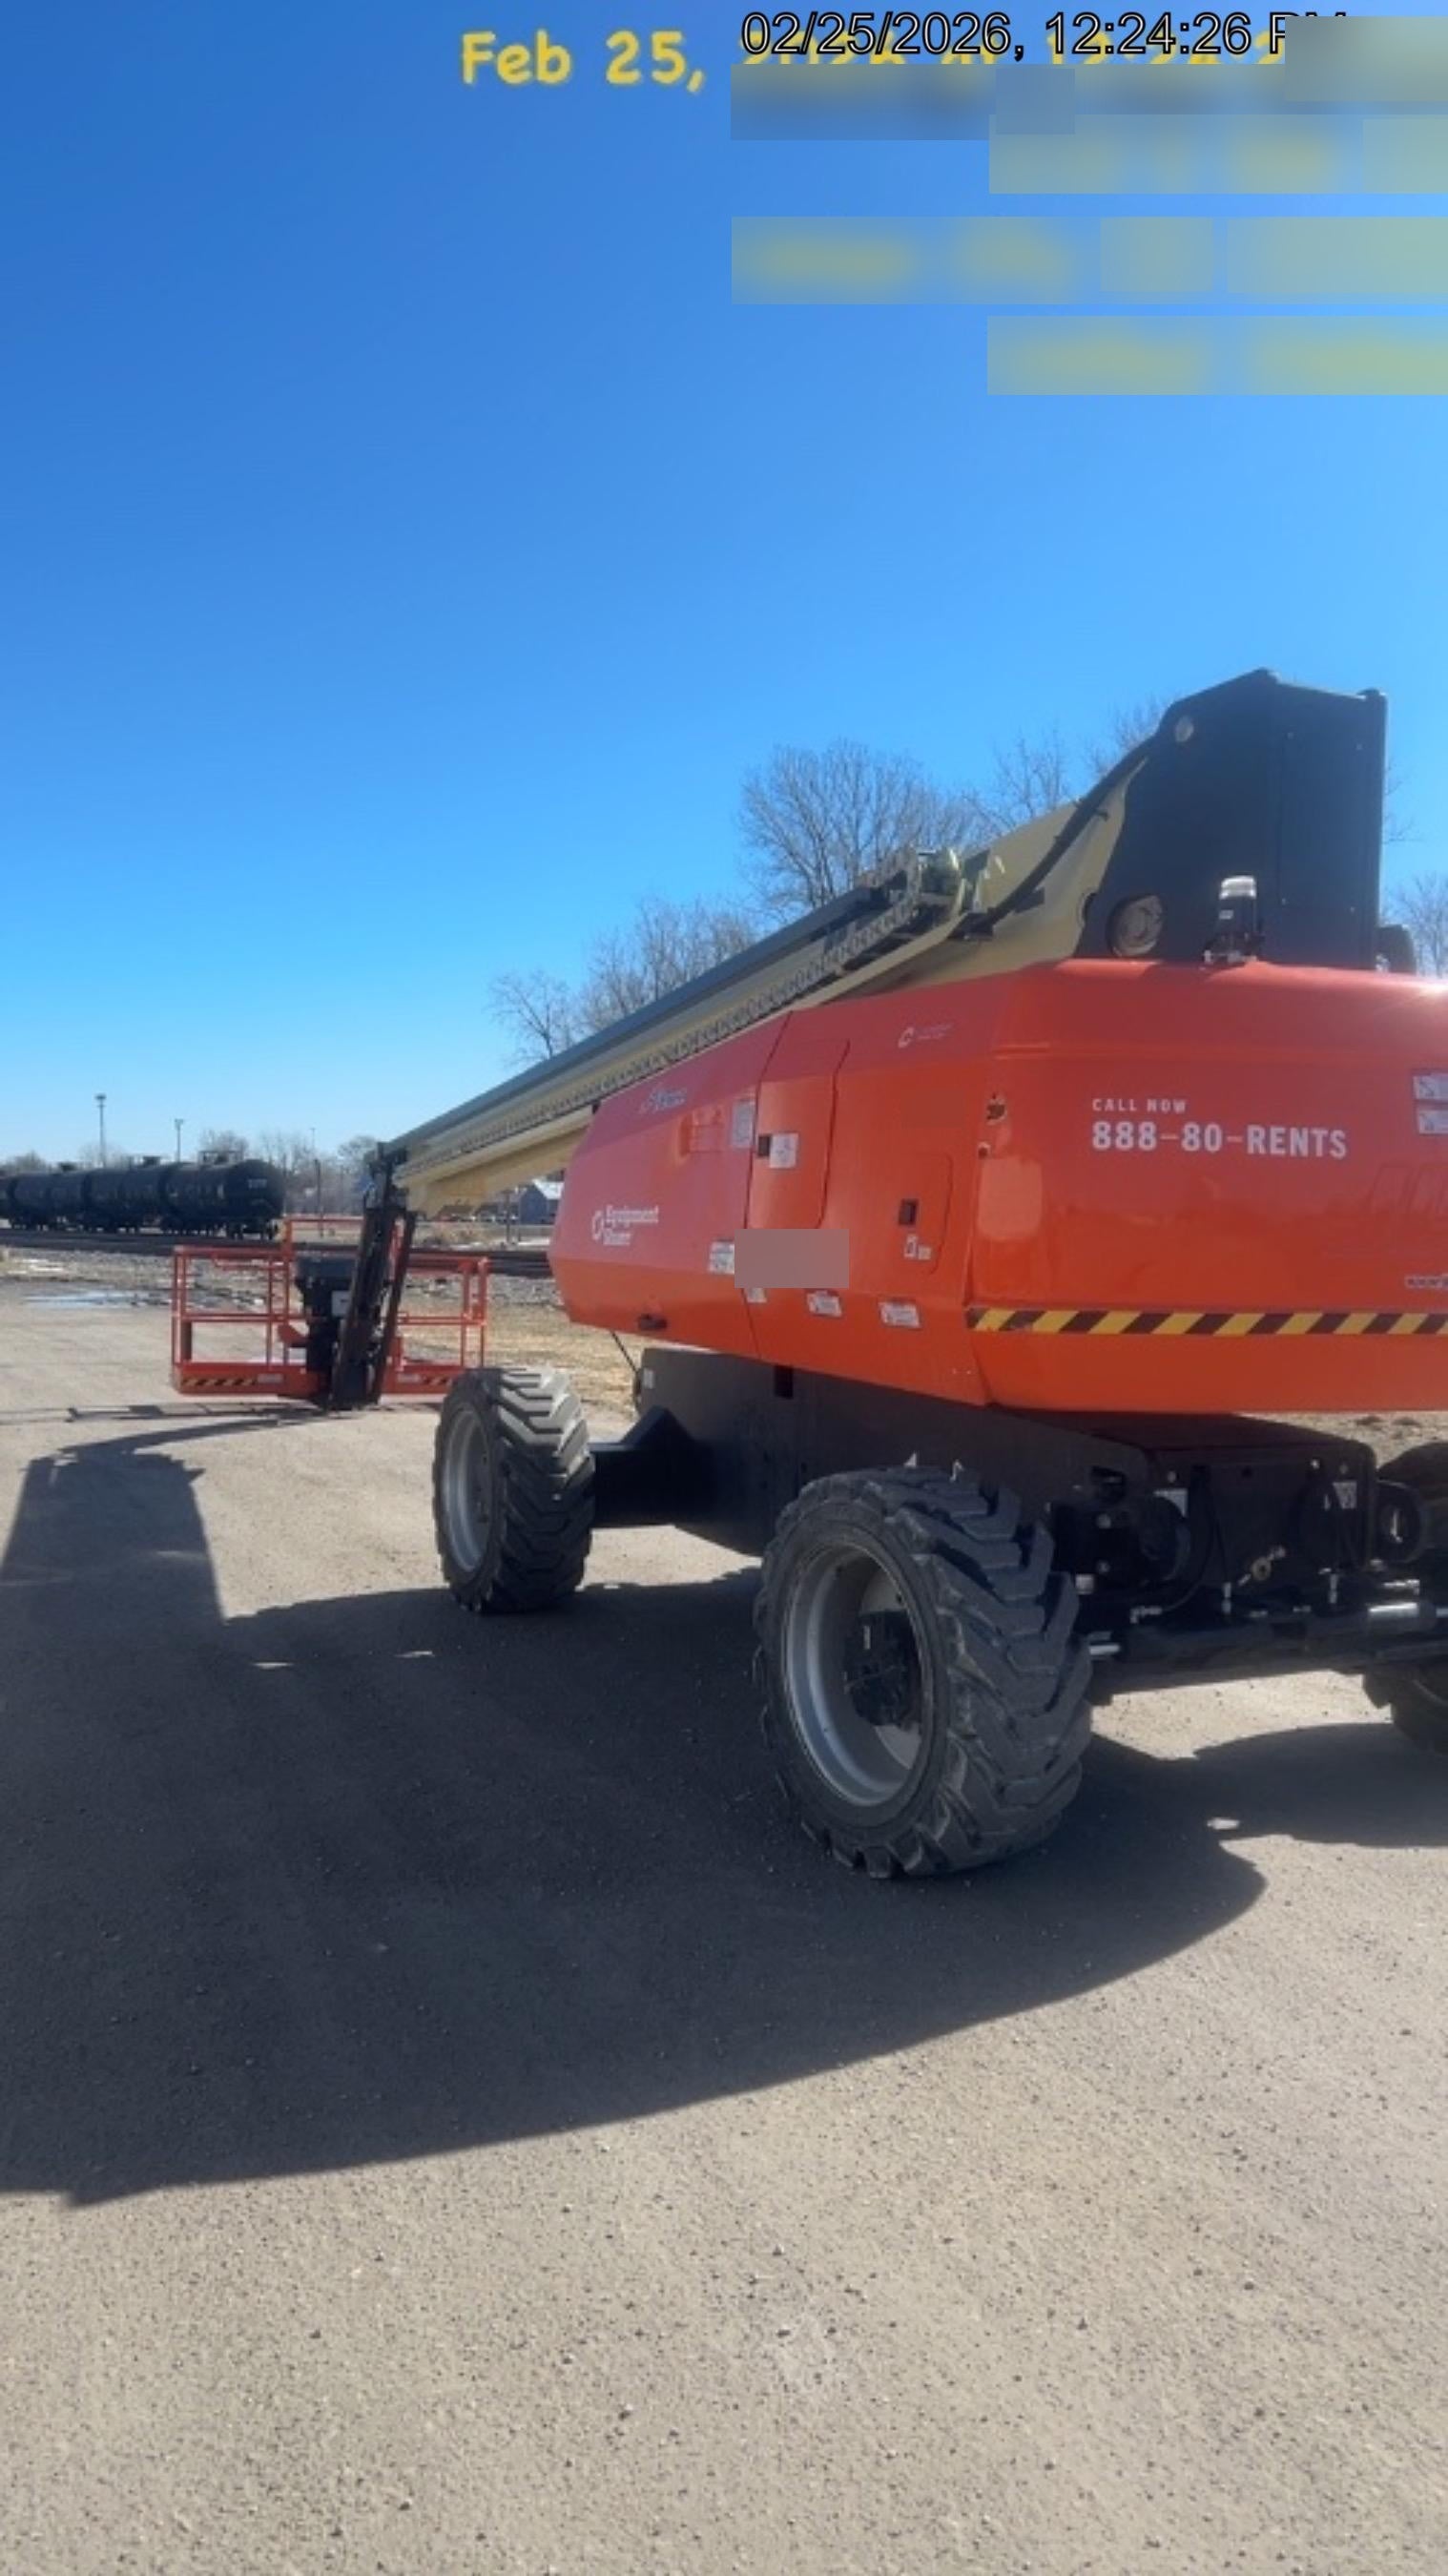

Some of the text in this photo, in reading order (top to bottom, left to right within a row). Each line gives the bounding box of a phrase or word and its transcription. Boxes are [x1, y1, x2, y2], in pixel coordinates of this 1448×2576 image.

[1091, 1098, 1188, 1114] CALL NOW
[1091, 1120, 1348, 1159] 888-80-RENTS
